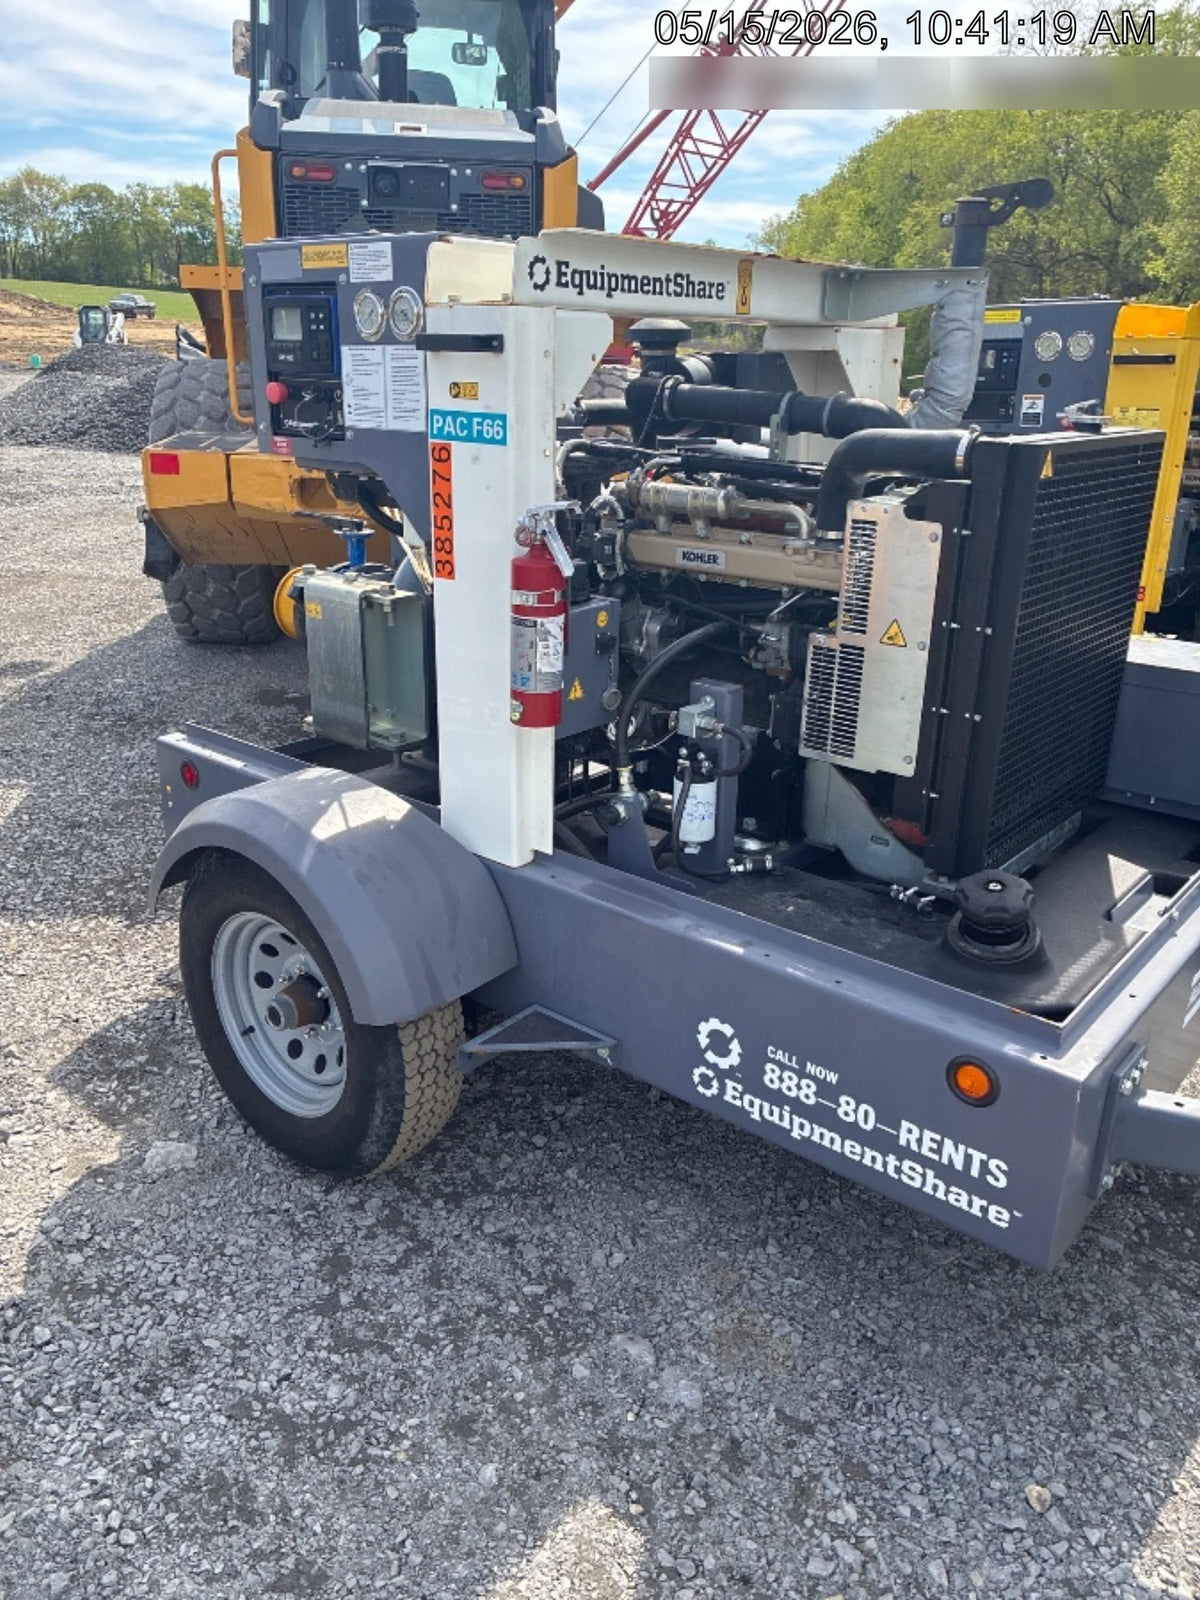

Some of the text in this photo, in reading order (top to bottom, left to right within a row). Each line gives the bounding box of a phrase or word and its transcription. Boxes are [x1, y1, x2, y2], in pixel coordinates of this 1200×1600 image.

[555, 260, 726, 301] EquipmentShare
[432, 415, 504, 440] PAC F66
[431, 446, 455, 577] 385276
[681, 550, 720, 565] KOHLER
[767, 1045, 839, 1085] CALL NOW
[723, 1080, 1010, 1229] EquipmentShare
